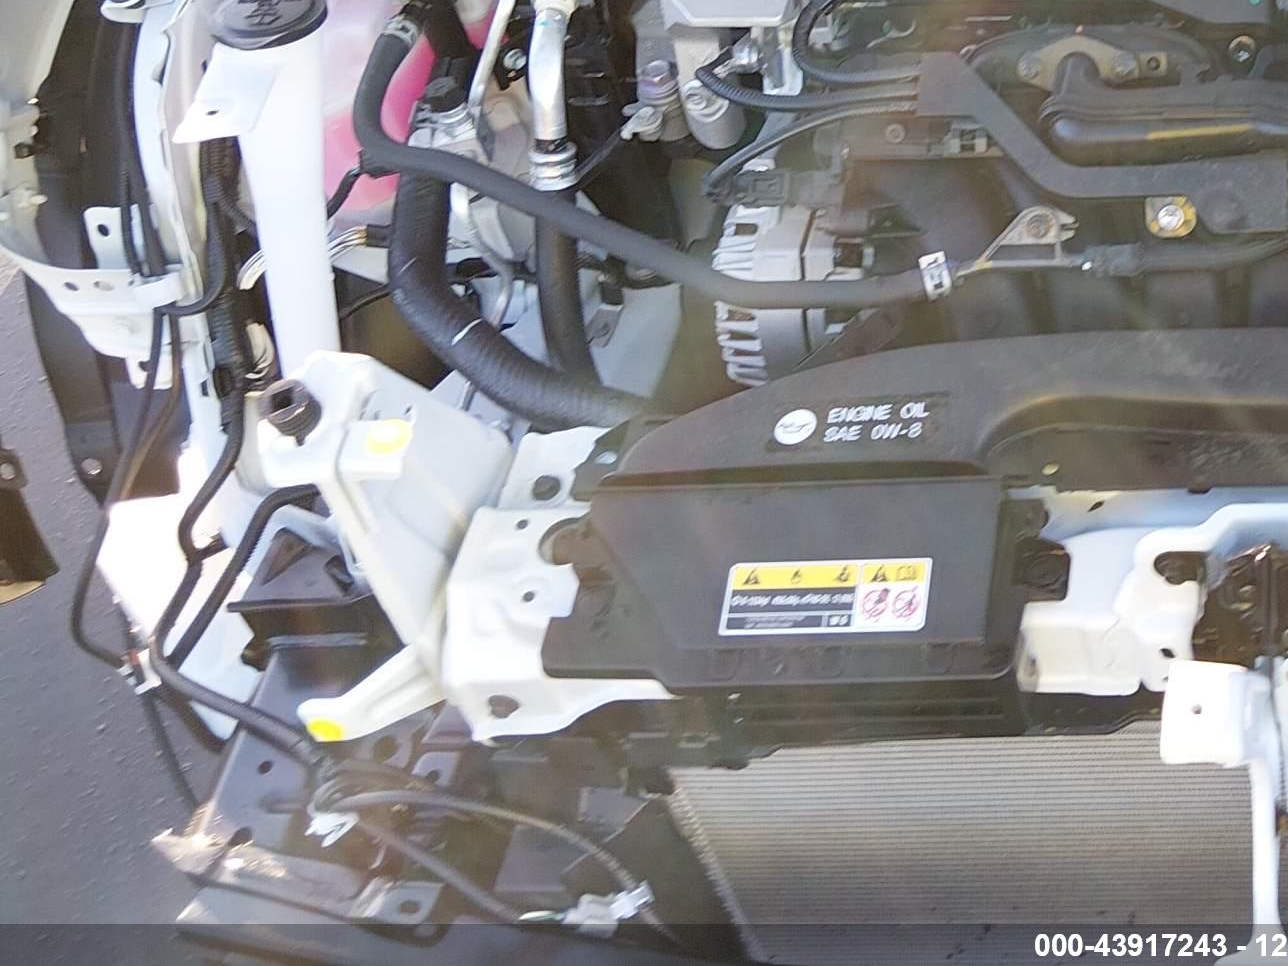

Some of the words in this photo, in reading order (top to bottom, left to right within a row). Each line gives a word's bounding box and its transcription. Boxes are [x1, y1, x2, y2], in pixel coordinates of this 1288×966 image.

[827, 404, 892, 424] ENGINE
[900, 402, 930, 420] OIL
[824, 425, 861, 442] SAE
